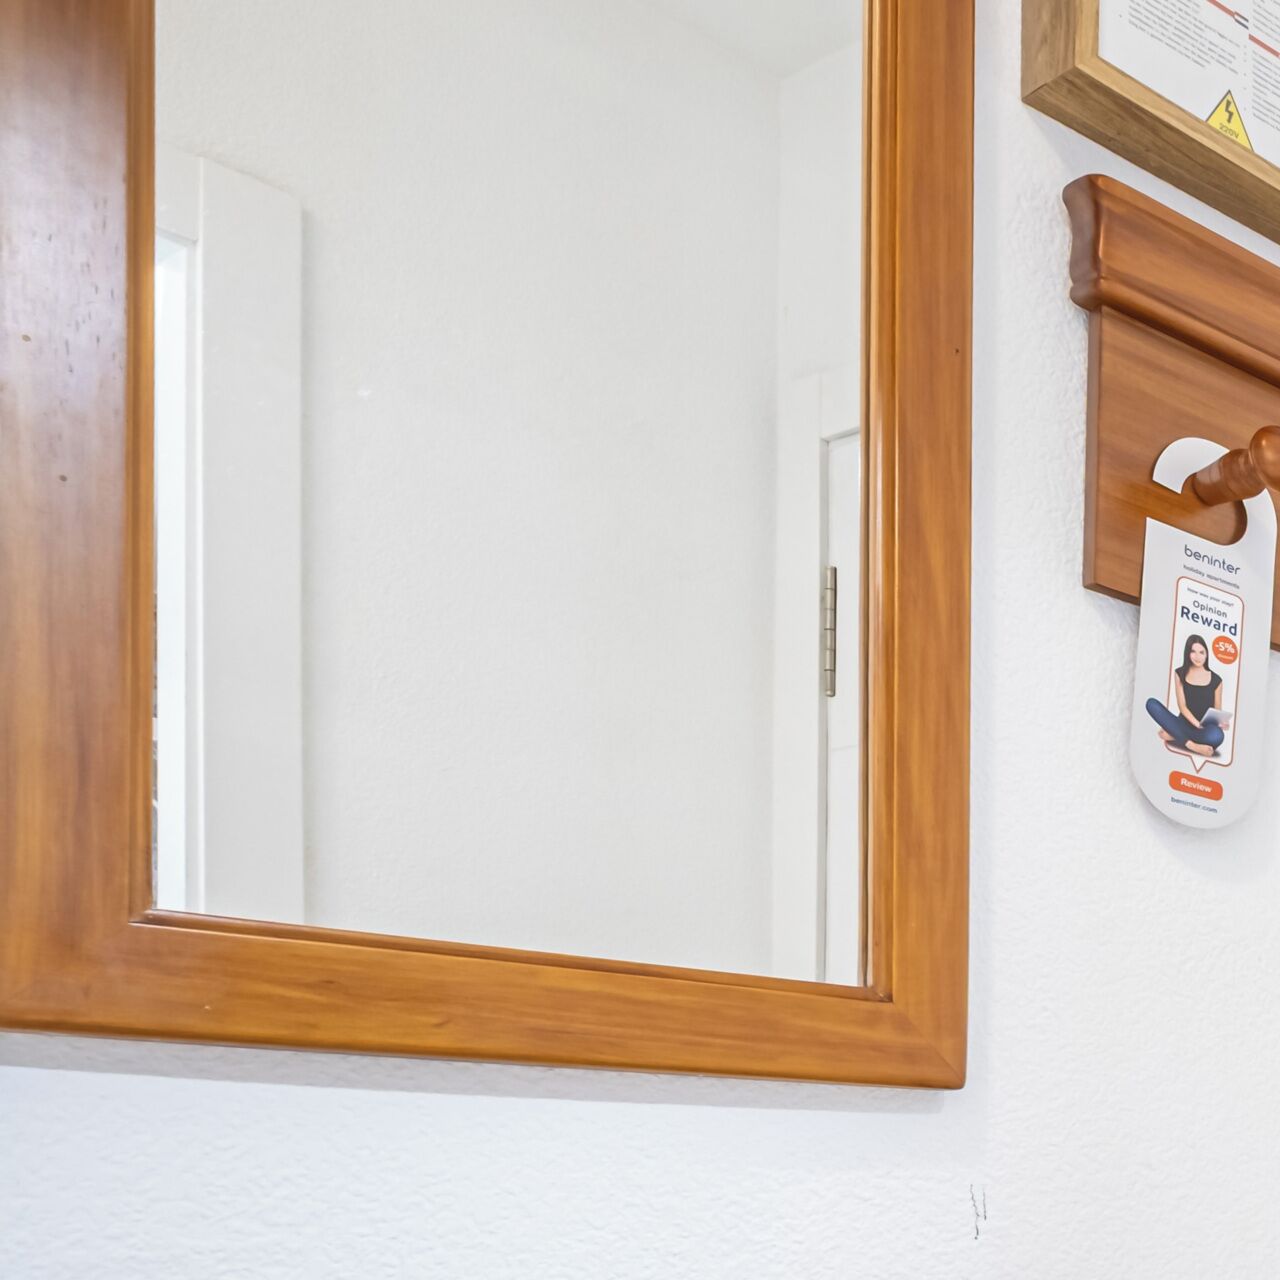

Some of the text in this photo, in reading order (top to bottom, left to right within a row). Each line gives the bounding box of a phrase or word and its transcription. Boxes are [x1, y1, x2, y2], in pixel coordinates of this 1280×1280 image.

[1219, 122, 1239, 139] 220V
[1184, 544, 1241, 575] beninter
[1183, 563, 1205, 577] holiday
[1192, 599, 1228, 619] Opinion
[1180, 605, 1238, 637] Reward
[1215, 641, 1236, 654] -5%
[1180, 777, 1213, 793] Review
[1170, 796, 1218, 814] beninter.com
